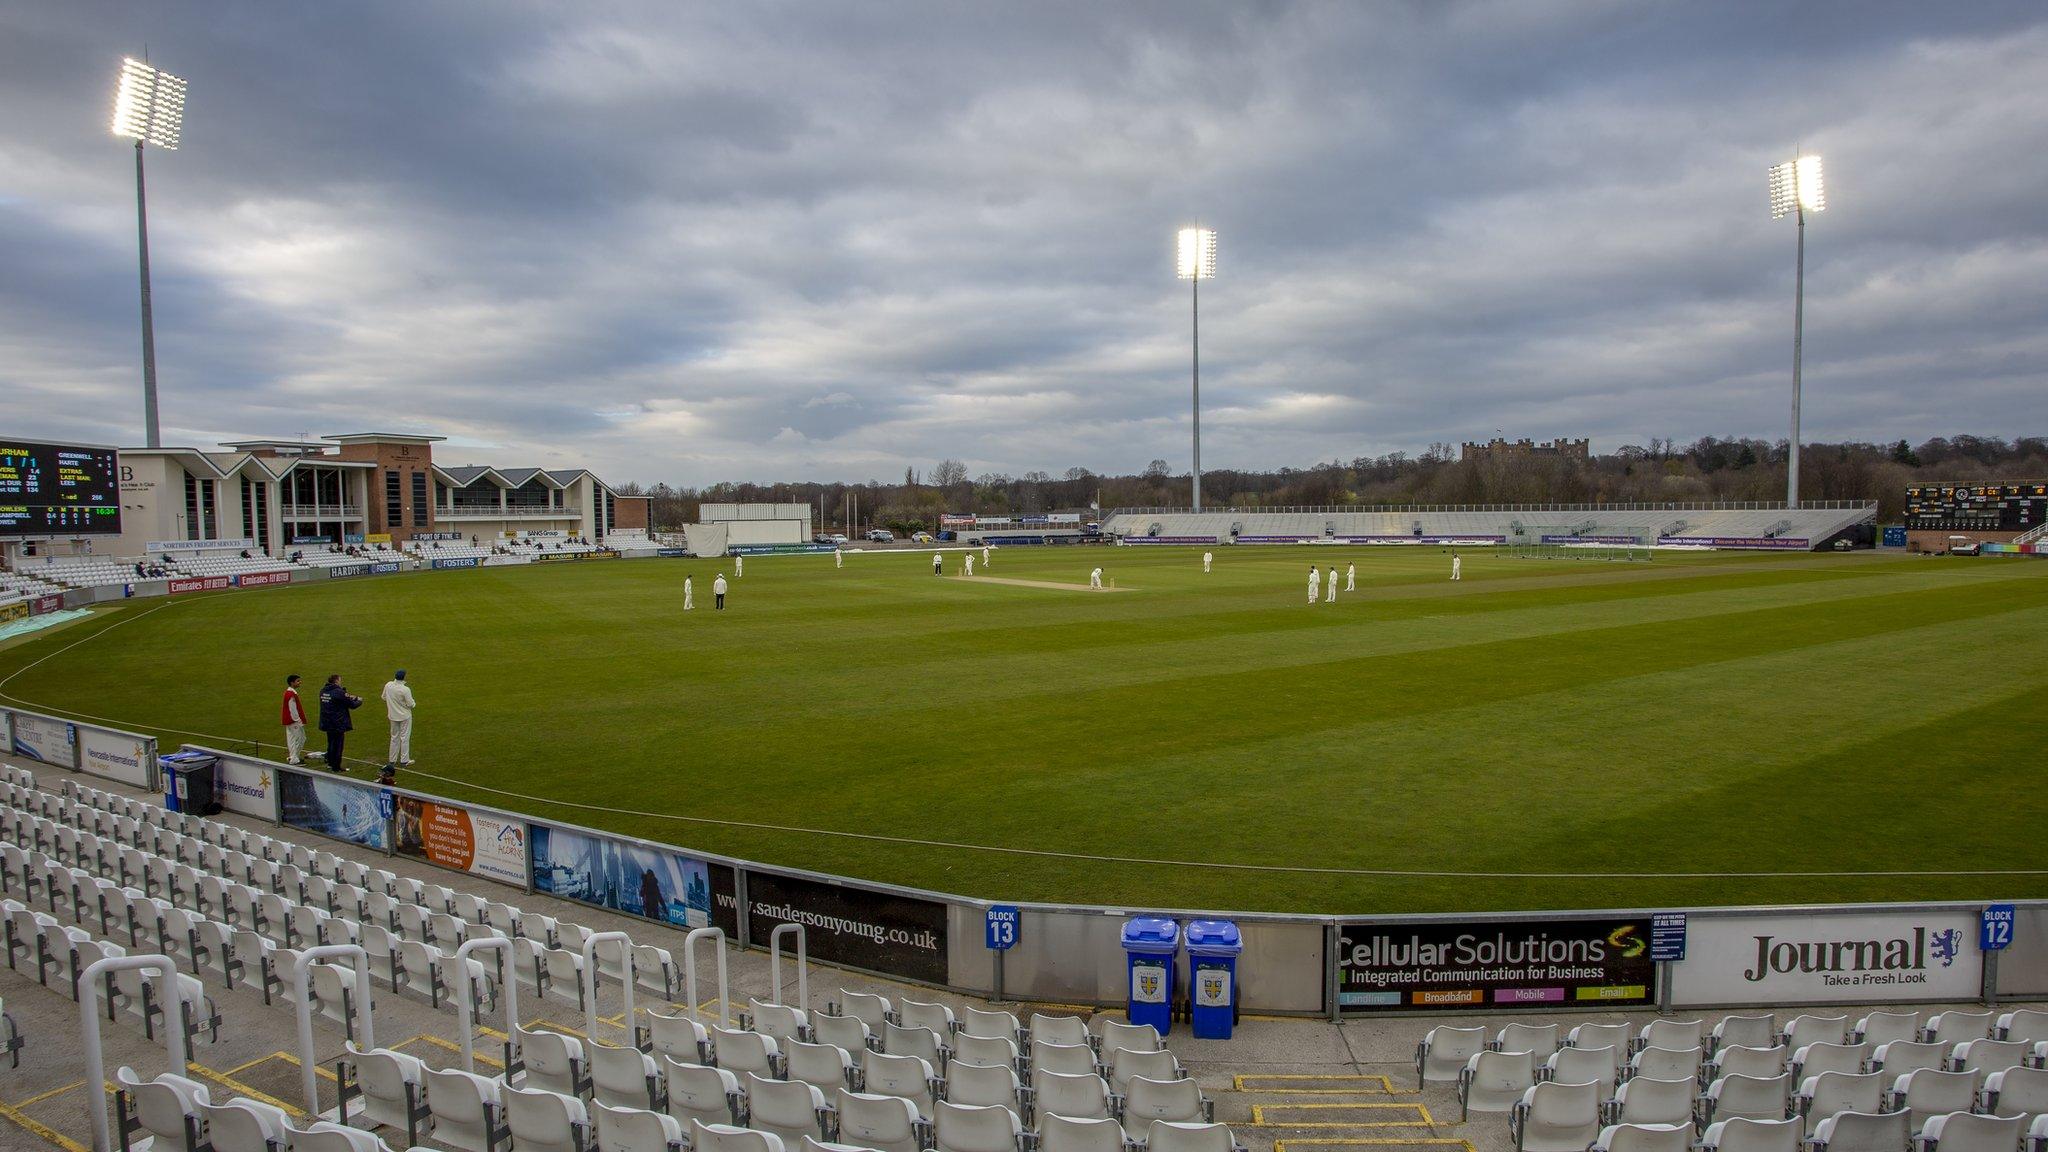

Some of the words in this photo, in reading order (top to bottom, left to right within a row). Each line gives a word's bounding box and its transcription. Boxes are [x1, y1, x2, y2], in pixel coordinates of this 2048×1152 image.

[120, 465, 133, 481] B
[171, 581, 203, 592] Emirates
[242, 575, 268, 585] Emirates
[109, 751, 139, 768] International
[227, 780, 265, 799] International
[670, 908, 685, 920] ITPS
[988, 911, 1015, 921] BLOCK
[1984, 911, 2012, 921] BLOCK
[991, 921, 1013, 943] 13
[1986, 921, 2009, 943] 12
[1454, 932, 1606, 965] Solutions
[1744, 926, 1927, 982] Journal
[1351, 968, 1420, 987] Integrated
[1423, 966, 1525, 983] Communication
[1527, 965, 1546, 979] for
[1548, 965, 1605, 979] Business
[1822, 974, 1850, 986] Take
[1852, 976, 1860, 986] a
[1862, 973, 1896, 985] Fresh
[1898, 972, 1927, 984] Look
[1424, 990, 1472, 1003] Broadband
[1515, 988, 1545, 1000] Mobile
[1600, 987, 1624, 998] Email
